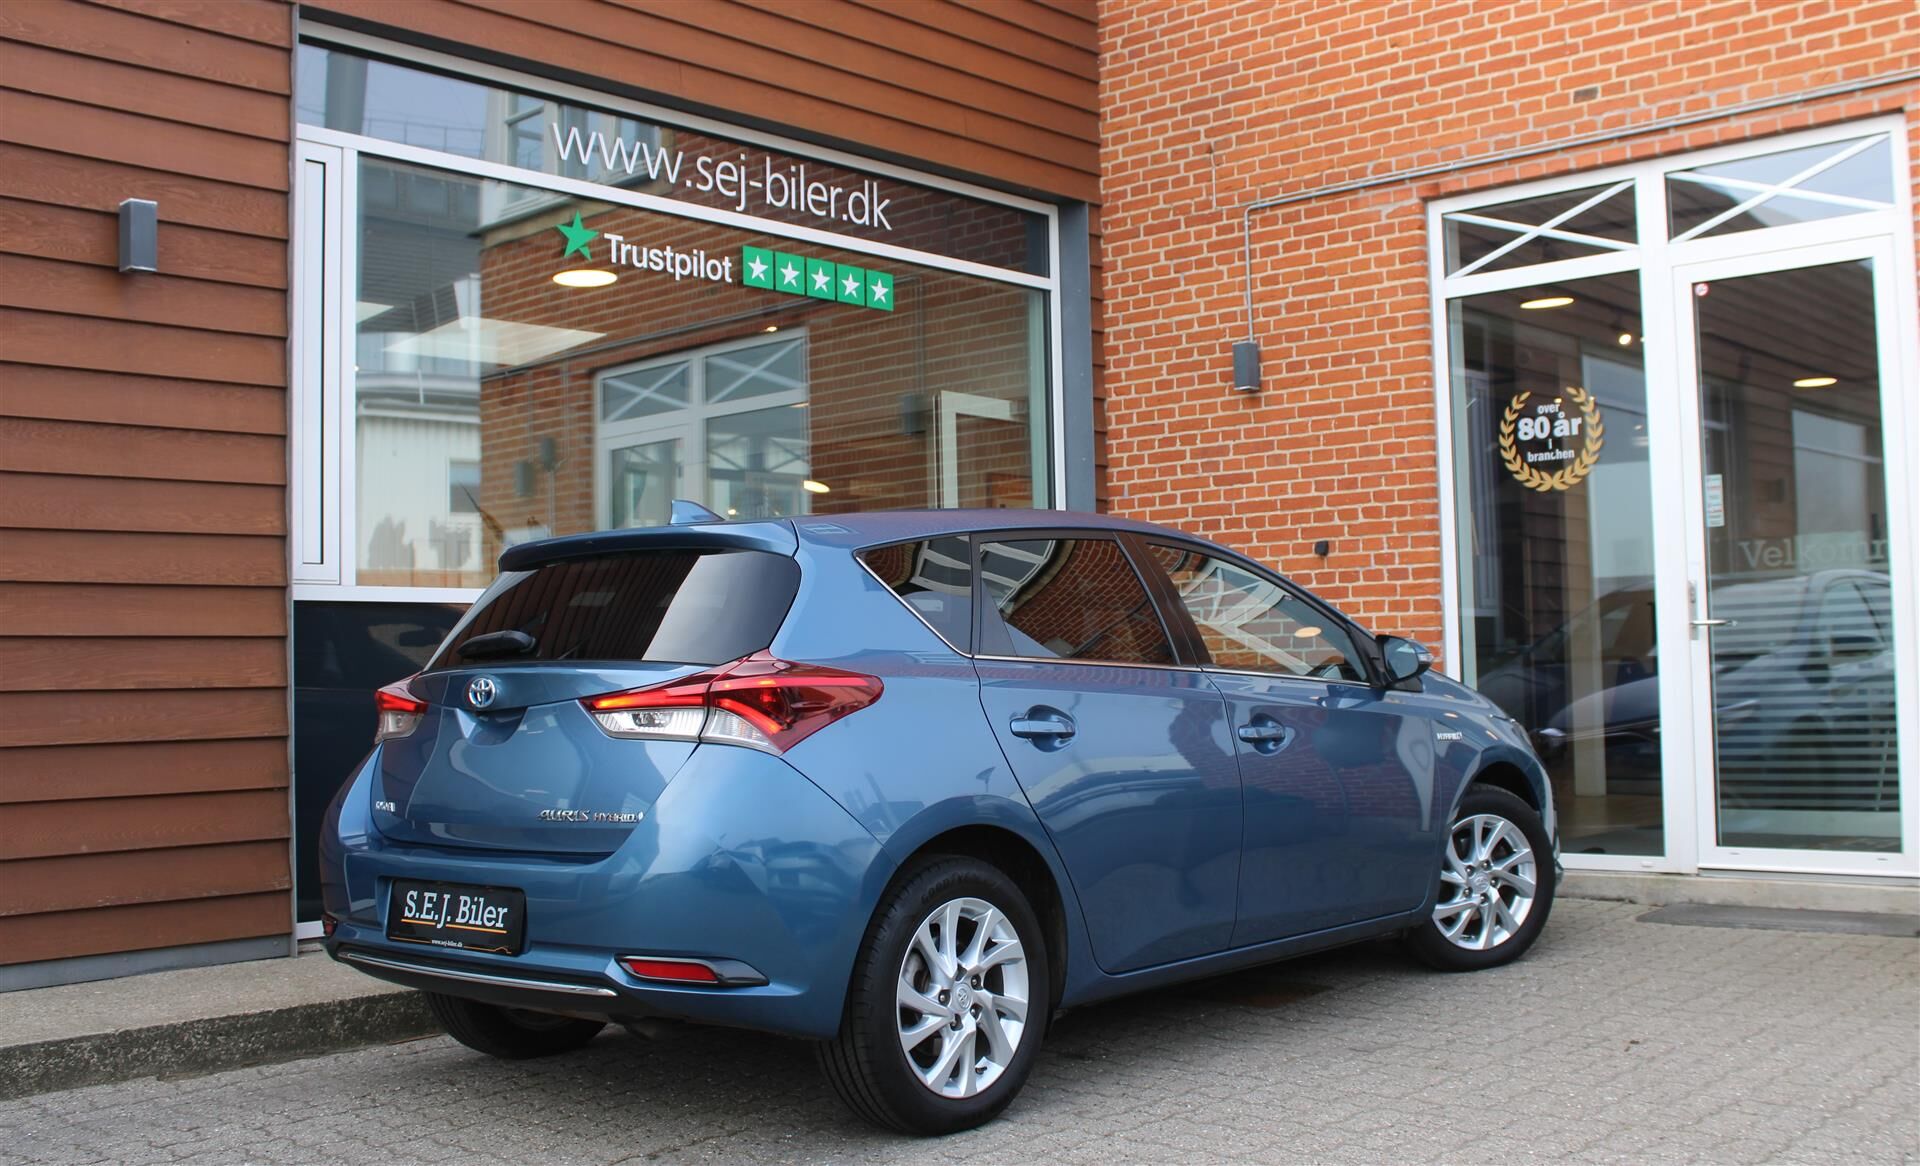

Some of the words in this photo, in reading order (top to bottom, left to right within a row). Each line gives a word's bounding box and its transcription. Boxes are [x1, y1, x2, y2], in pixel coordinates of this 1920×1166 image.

[552, 122, 893, 230] www.sej-biler.dk
[603, 232, 733, 283] Trustpilot
[1518, 416, 1550, 440] 80
[1553, 411, 1582, 437] år
[1537, 403, 1560, 414] over
[537, 808, 590, 822] AURIS
[404, 890, 451, 929] S.E.J.
[455, 895, 508, 928] Biler
